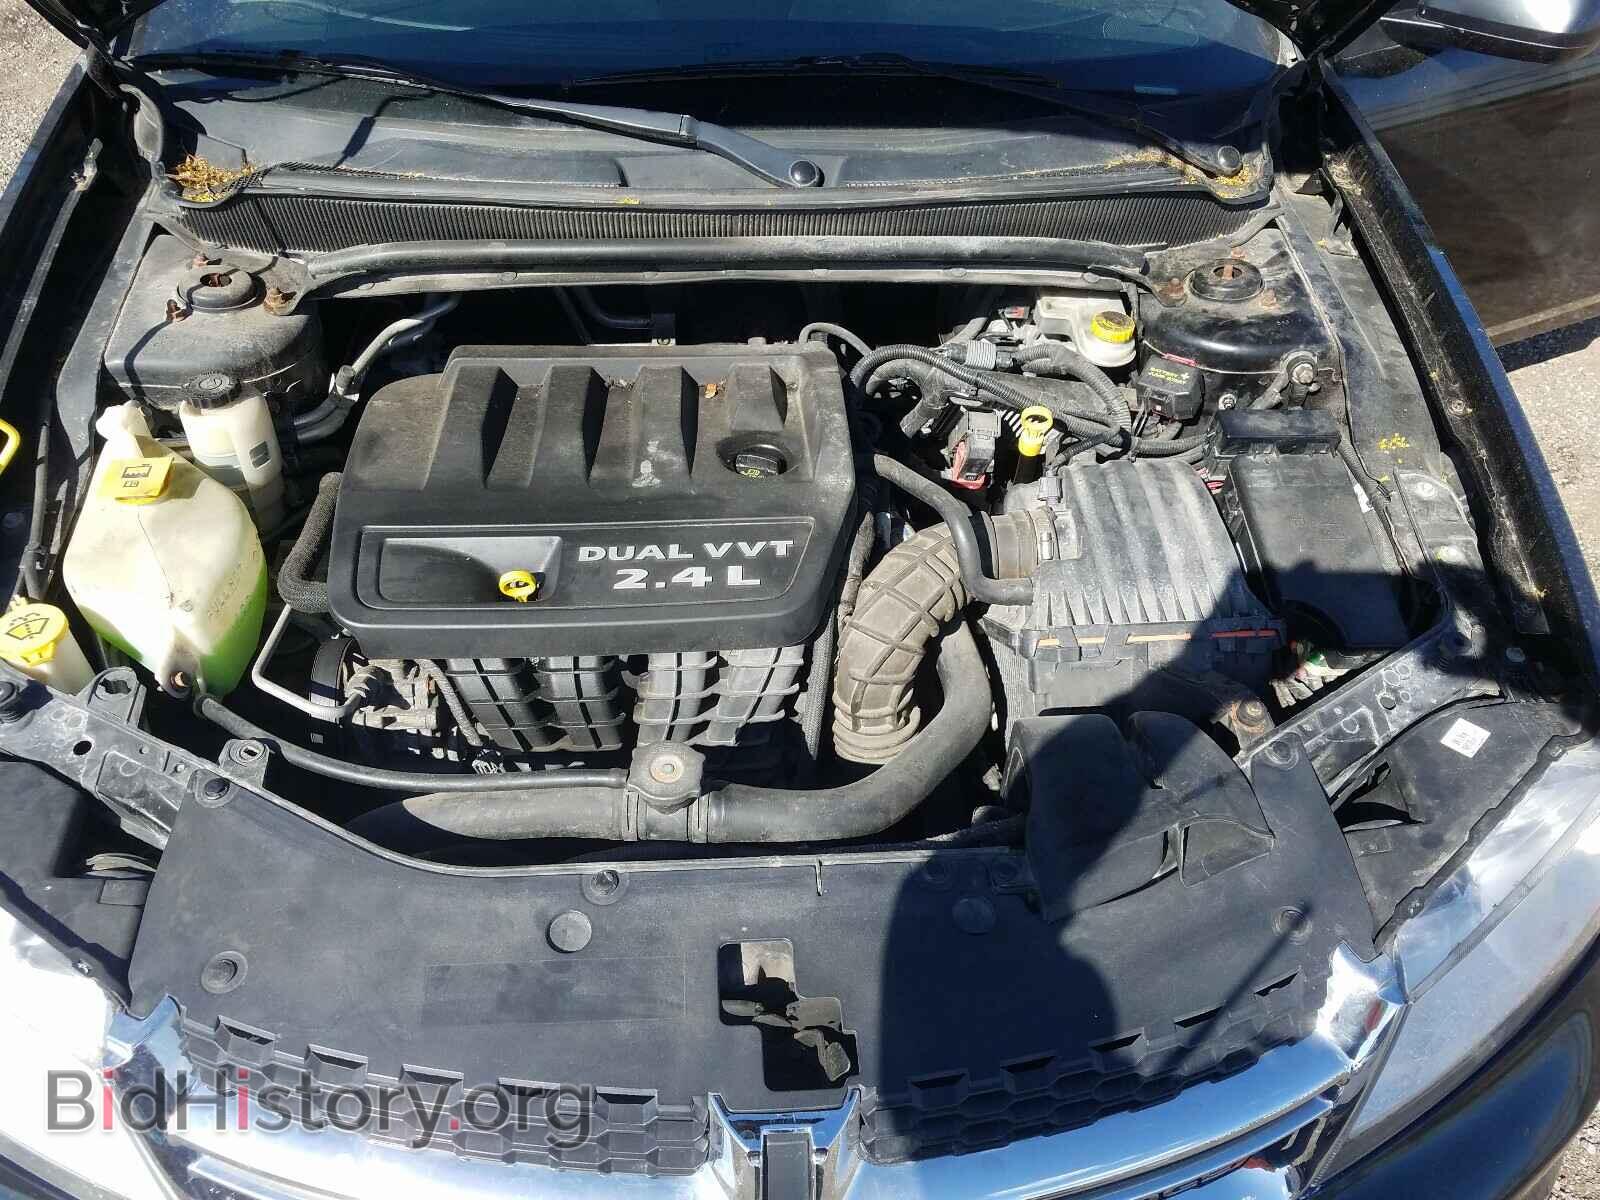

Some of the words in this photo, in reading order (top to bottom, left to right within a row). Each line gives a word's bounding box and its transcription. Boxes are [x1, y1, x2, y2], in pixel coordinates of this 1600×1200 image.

[578, 544, 694, 562] DUAL
[704, 540, 794, 558] VVT
[613, 567, 712, 589] 2.4
[727, 565, 761, 586] L
